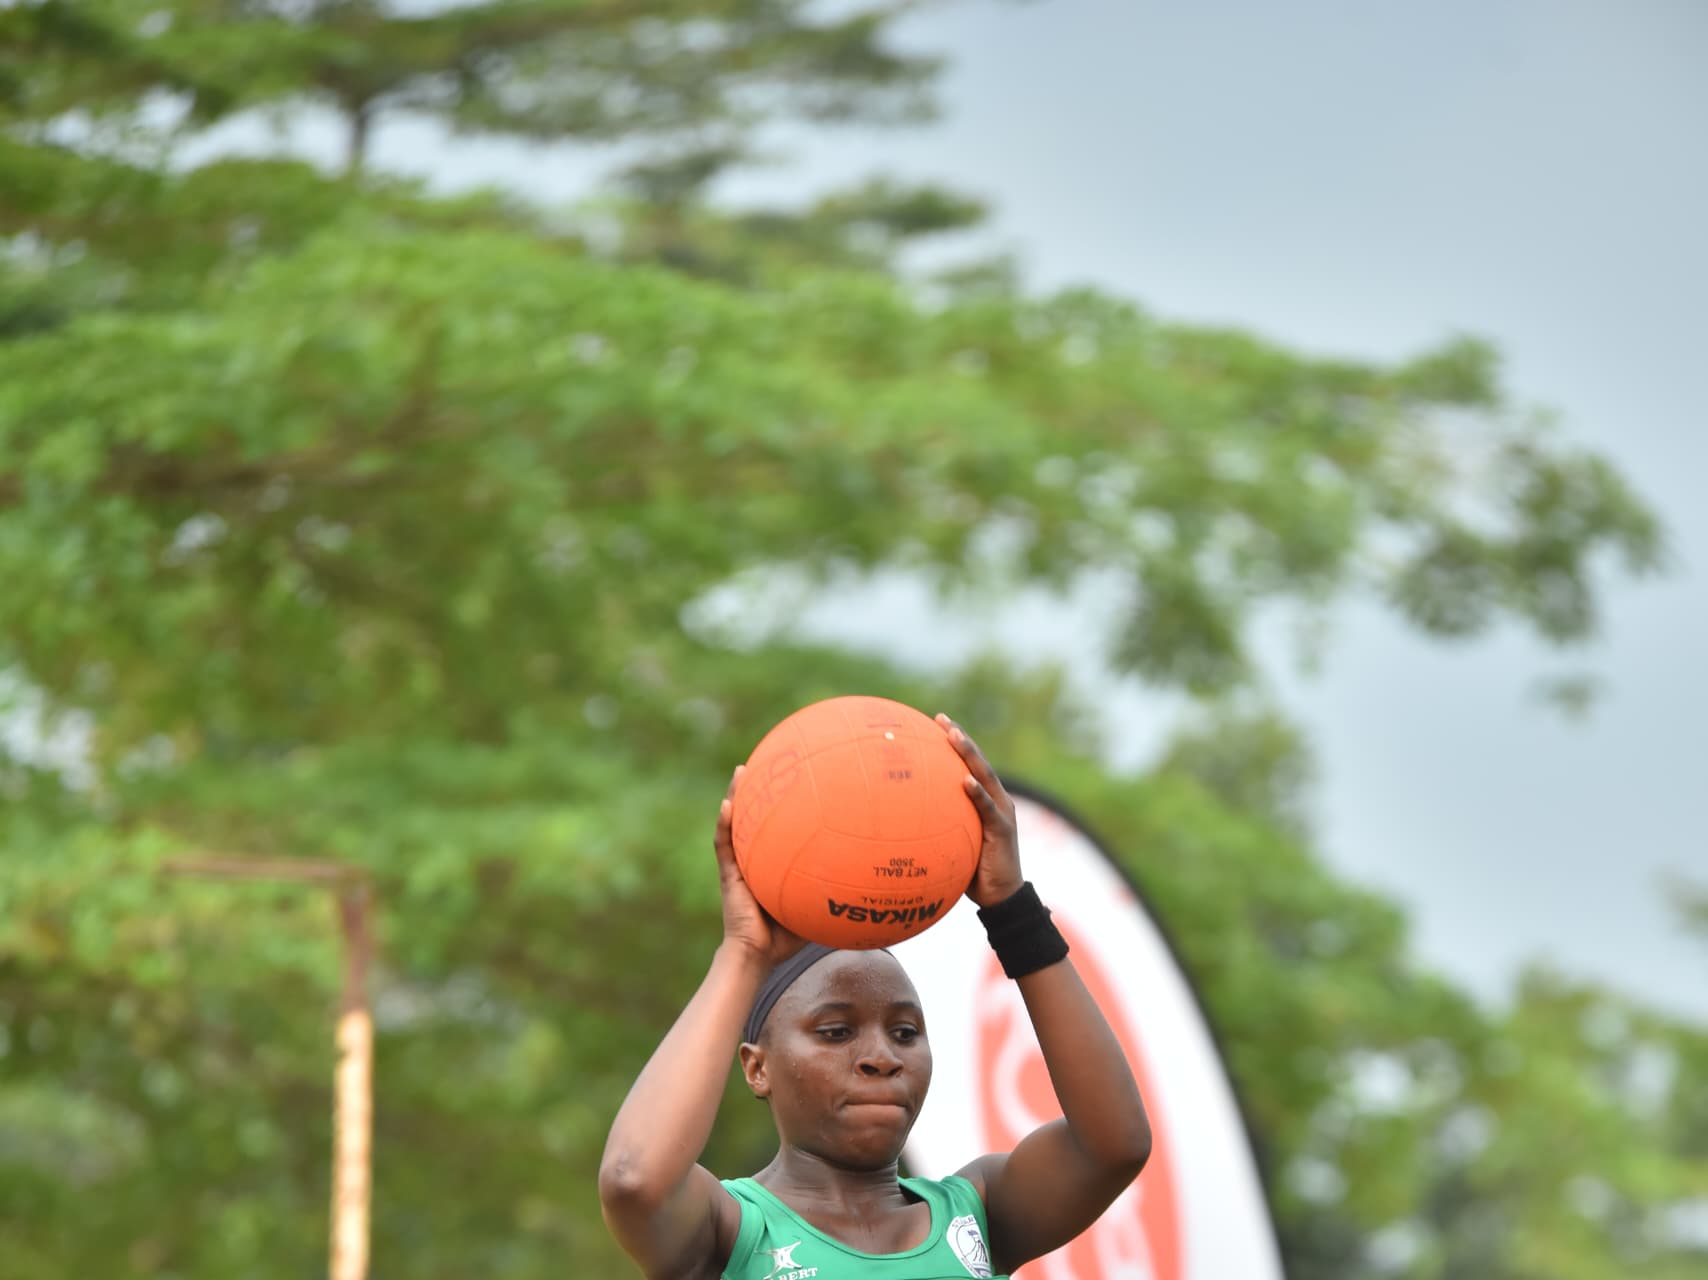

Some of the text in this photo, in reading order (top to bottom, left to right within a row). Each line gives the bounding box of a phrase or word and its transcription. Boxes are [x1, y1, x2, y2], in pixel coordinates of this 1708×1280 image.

[873, 866, 928, 878] NET BALL
[862, 895, 924, 906] OFFICIAL
